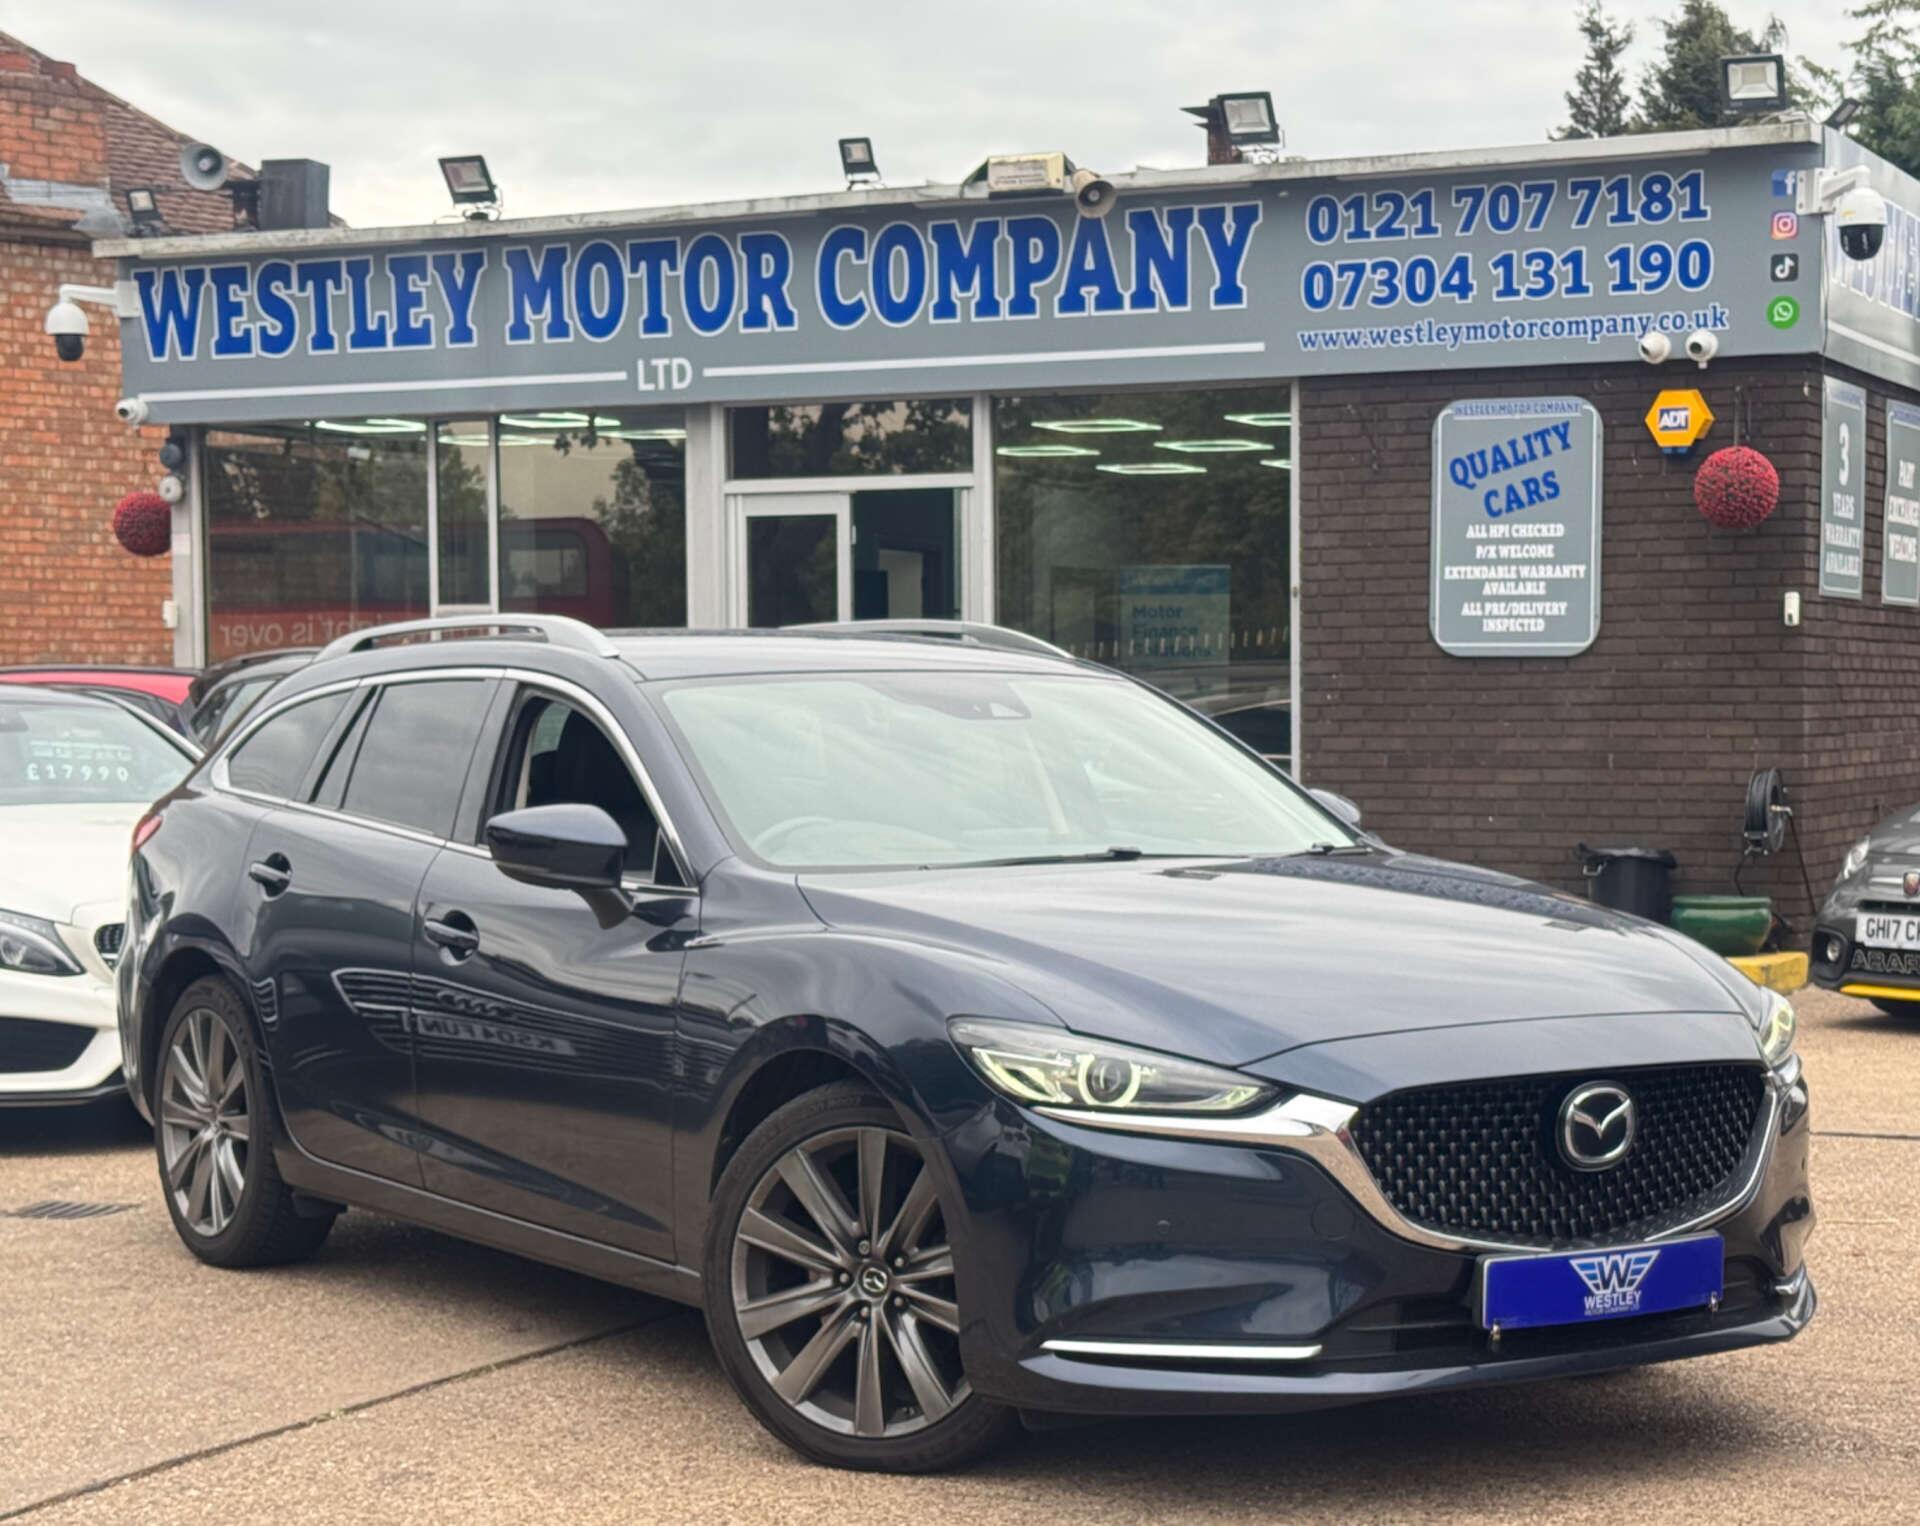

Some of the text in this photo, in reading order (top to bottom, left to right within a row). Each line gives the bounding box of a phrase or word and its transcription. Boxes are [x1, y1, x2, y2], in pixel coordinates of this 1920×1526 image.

[1305, 169, 1711, 245] 0121 707 7181
[131, 202, 1263, 362] WESTLEY MOTOR COMPANY
[1301, 239, 1712, 311] 07304 131 190
[1298, 302, 1729, 351] www.westleymotorcompany.co.uk
[637, 357, 693, 391] LTD
[1659, 409, 1689, 428] ADT
[1449, 421, 1572, 489] QUALITY
[1838, 422, 1850, 487] 3
[1484, 470, 1560, 518] CARS
[1466, 523, 1564, 538] ALL HPI CHECKED
[1476, 544, 1555, 559] P/X WELCOME
[1444, 564, 1586, 580] EXTENDABLE WARRANTY
[1482, 581, 1546, 595] AVAILABLE
[1461, 601, 1568, 616] ALL PRE/DELIVERY
[1483, 618, 1545, 632] INSPECTED
[1865, 917, 1901, 942] GH17
[1584, 1290, 1642, 1310] WESTLEY
